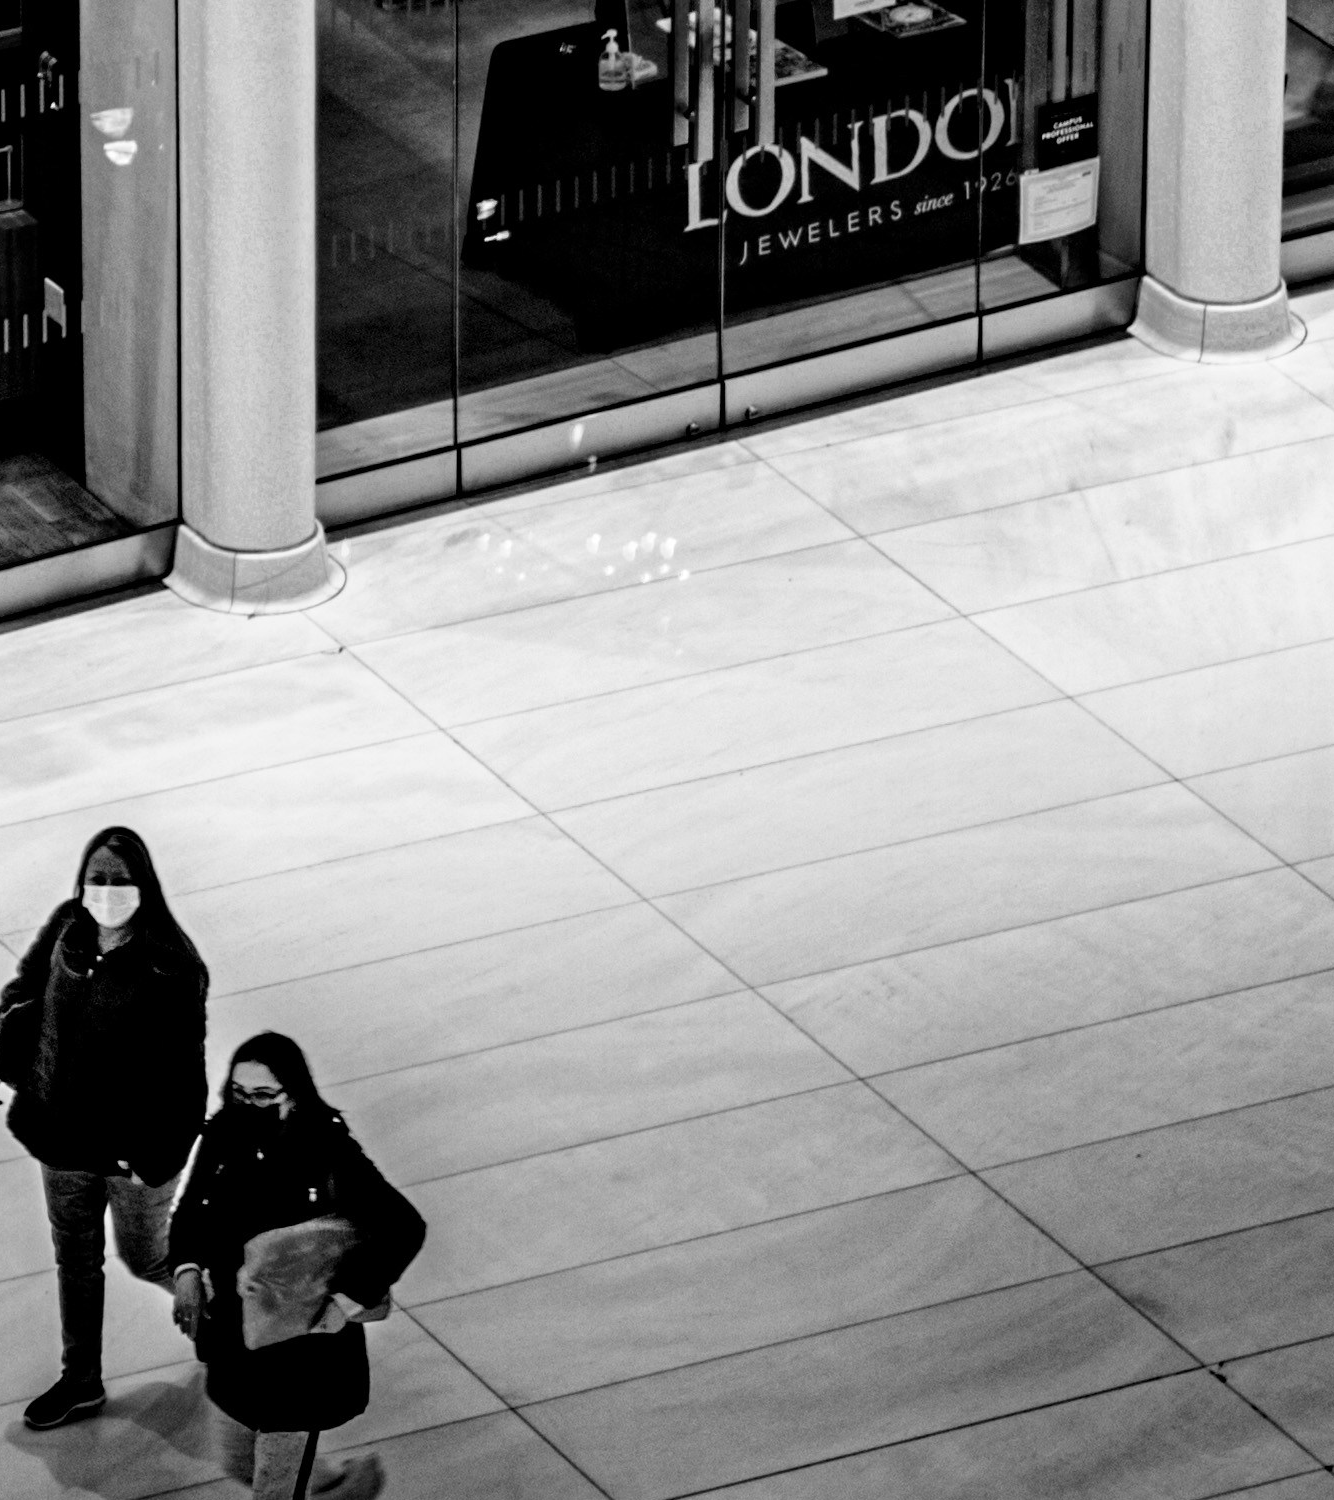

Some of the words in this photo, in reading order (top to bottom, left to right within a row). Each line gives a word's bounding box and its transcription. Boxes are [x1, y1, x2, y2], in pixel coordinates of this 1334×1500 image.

[1041, 121, 1095, 140] PROFESSIONAL
[1053, 116, 1083, 129] CAMPUS
[1056, 132, 1080, 145] OFFER
[739, 200, 903, 266] JEWELERS
[914, 192, 954, 216] since
[964, 168, 1017, 200] 1926
